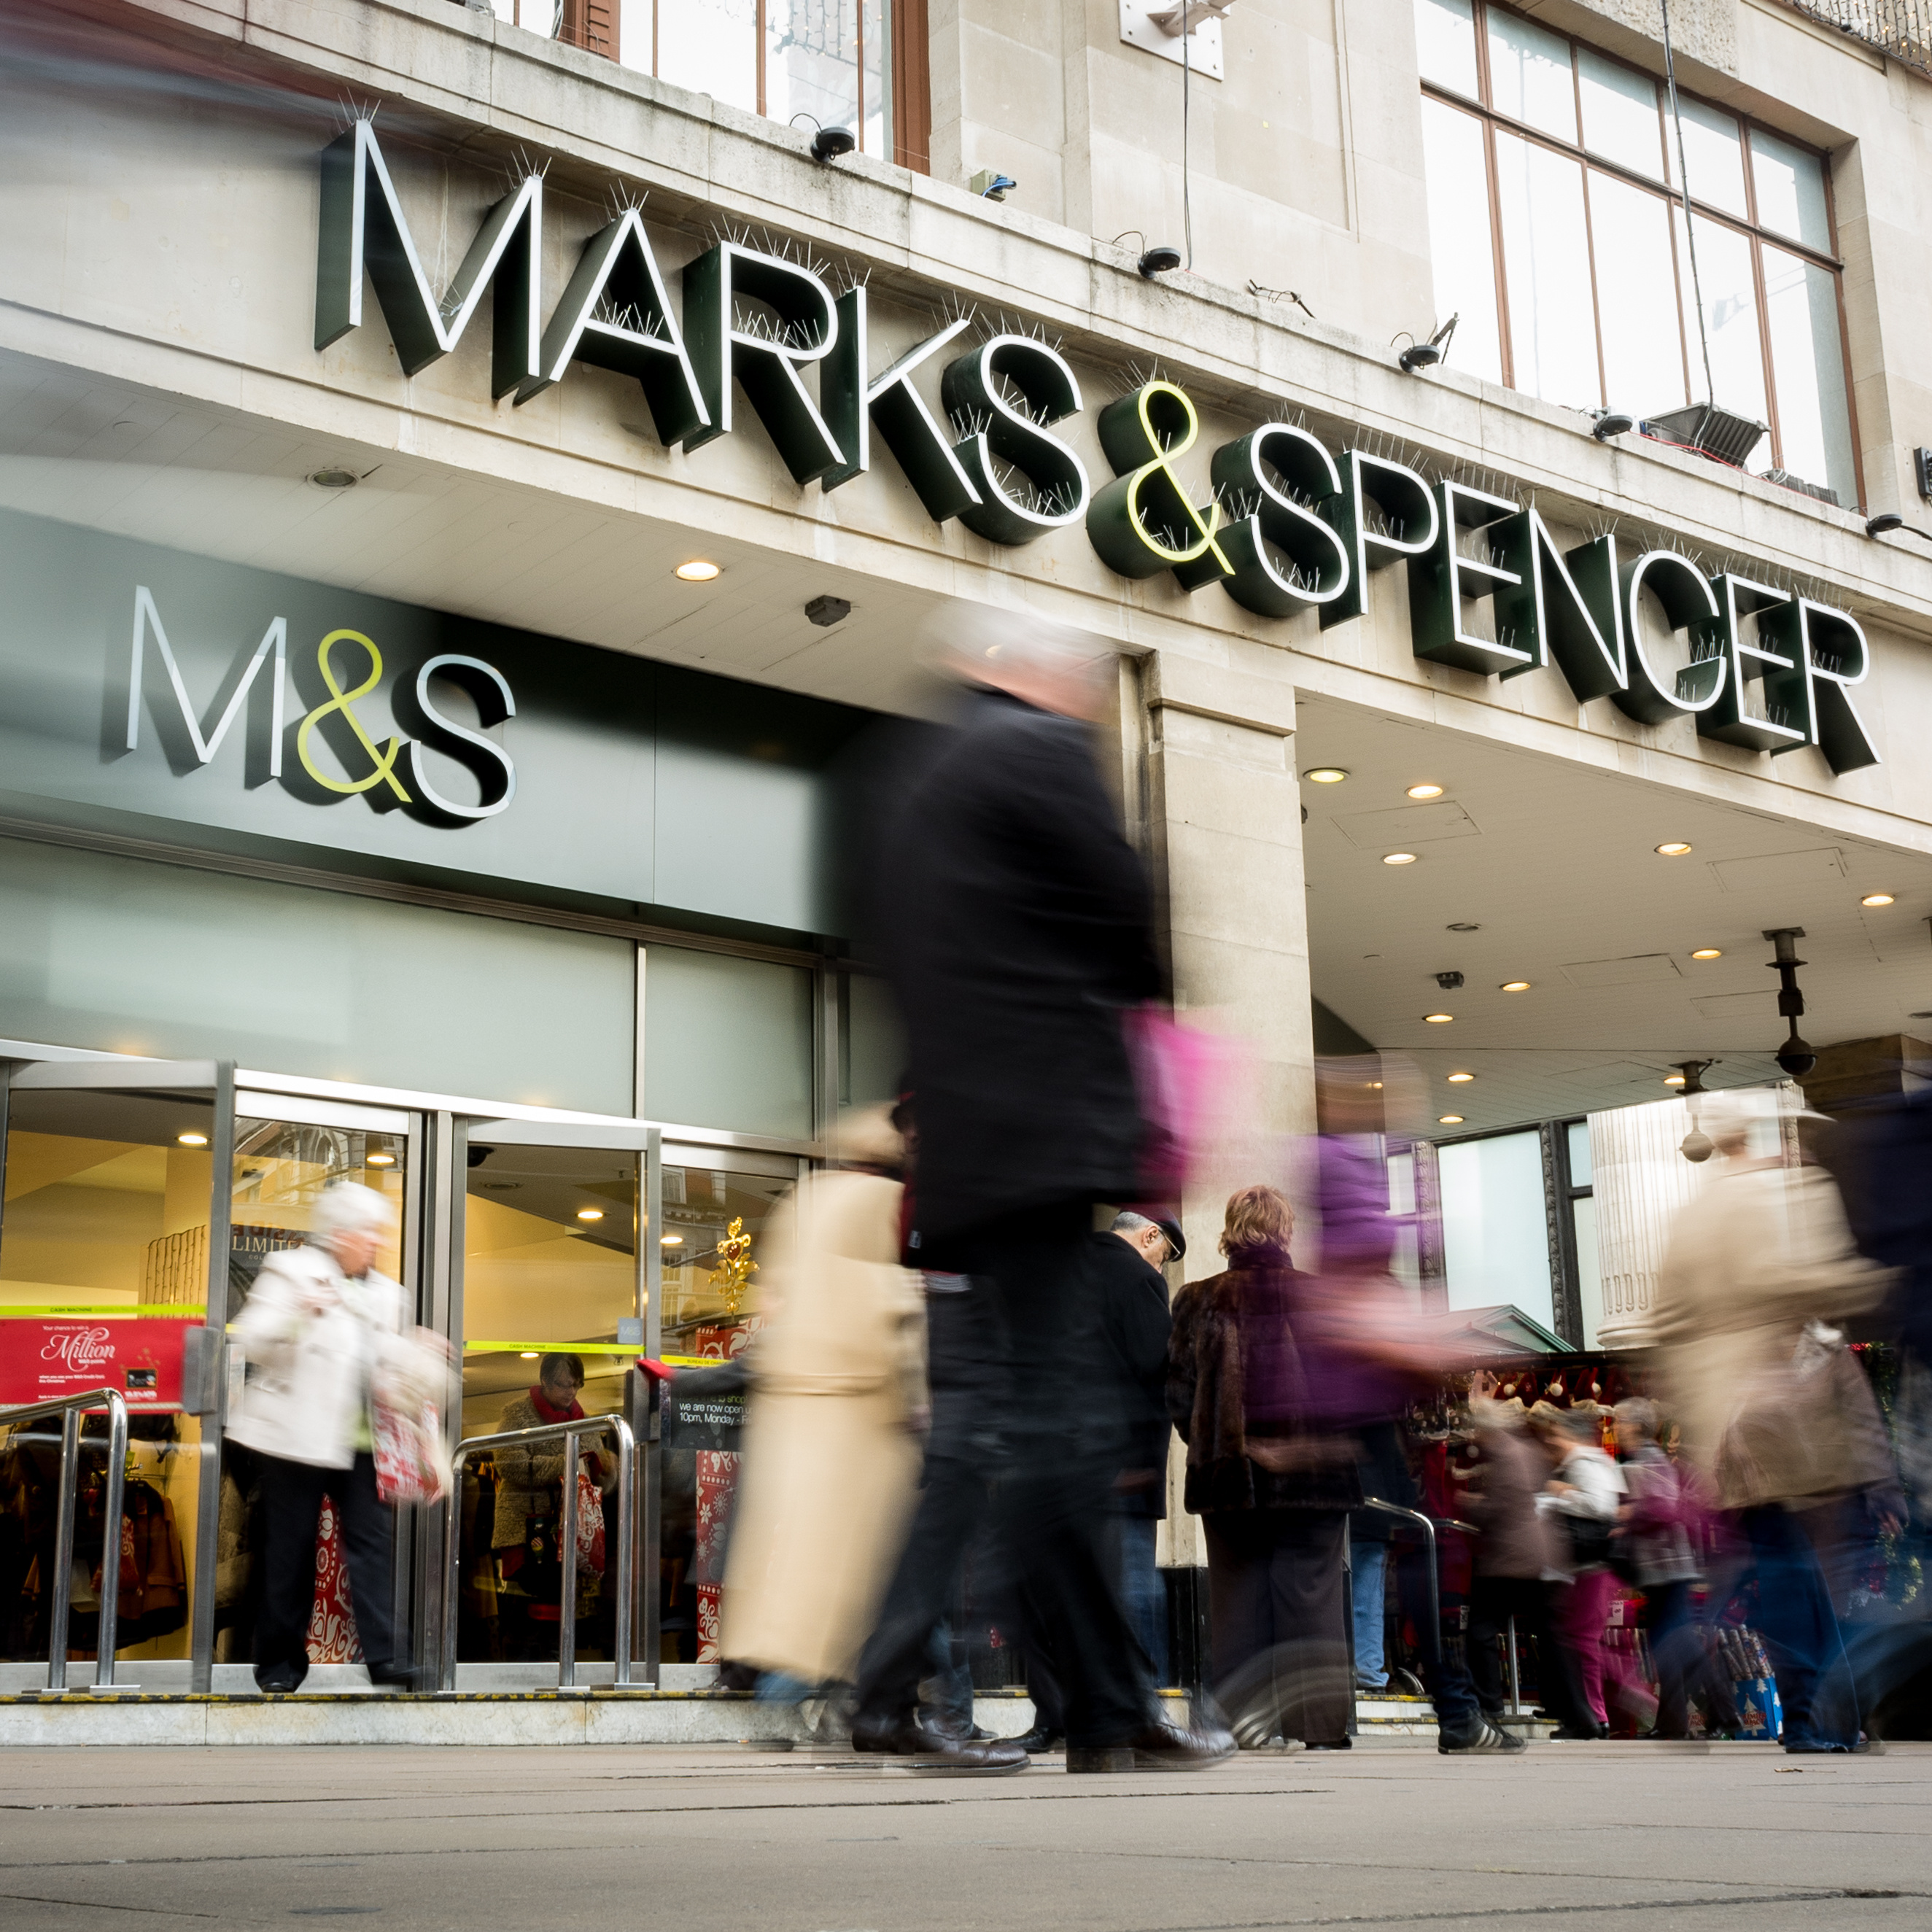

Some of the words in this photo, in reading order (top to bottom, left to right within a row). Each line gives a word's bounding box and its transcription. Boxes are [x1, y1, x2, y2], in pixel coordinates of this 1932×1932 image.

[348, 119, 1090, 527] MARKS
[1127, 380, 1235, 575] &
[1250, 422, 1882, 764] SPENCER
[126, 584, 517, 818] M&S
[231, 1235, 305, 1253] LIMITE
[40, 1327, 115, 1373] Million
[679, 1403, 691, 1411] we
[692, 1403, 705, 1412] are
[706, 1404, 723, 1413] now
[723, 1405, 744, 1415] open
[704, 1413, 735, 1426] Monday
